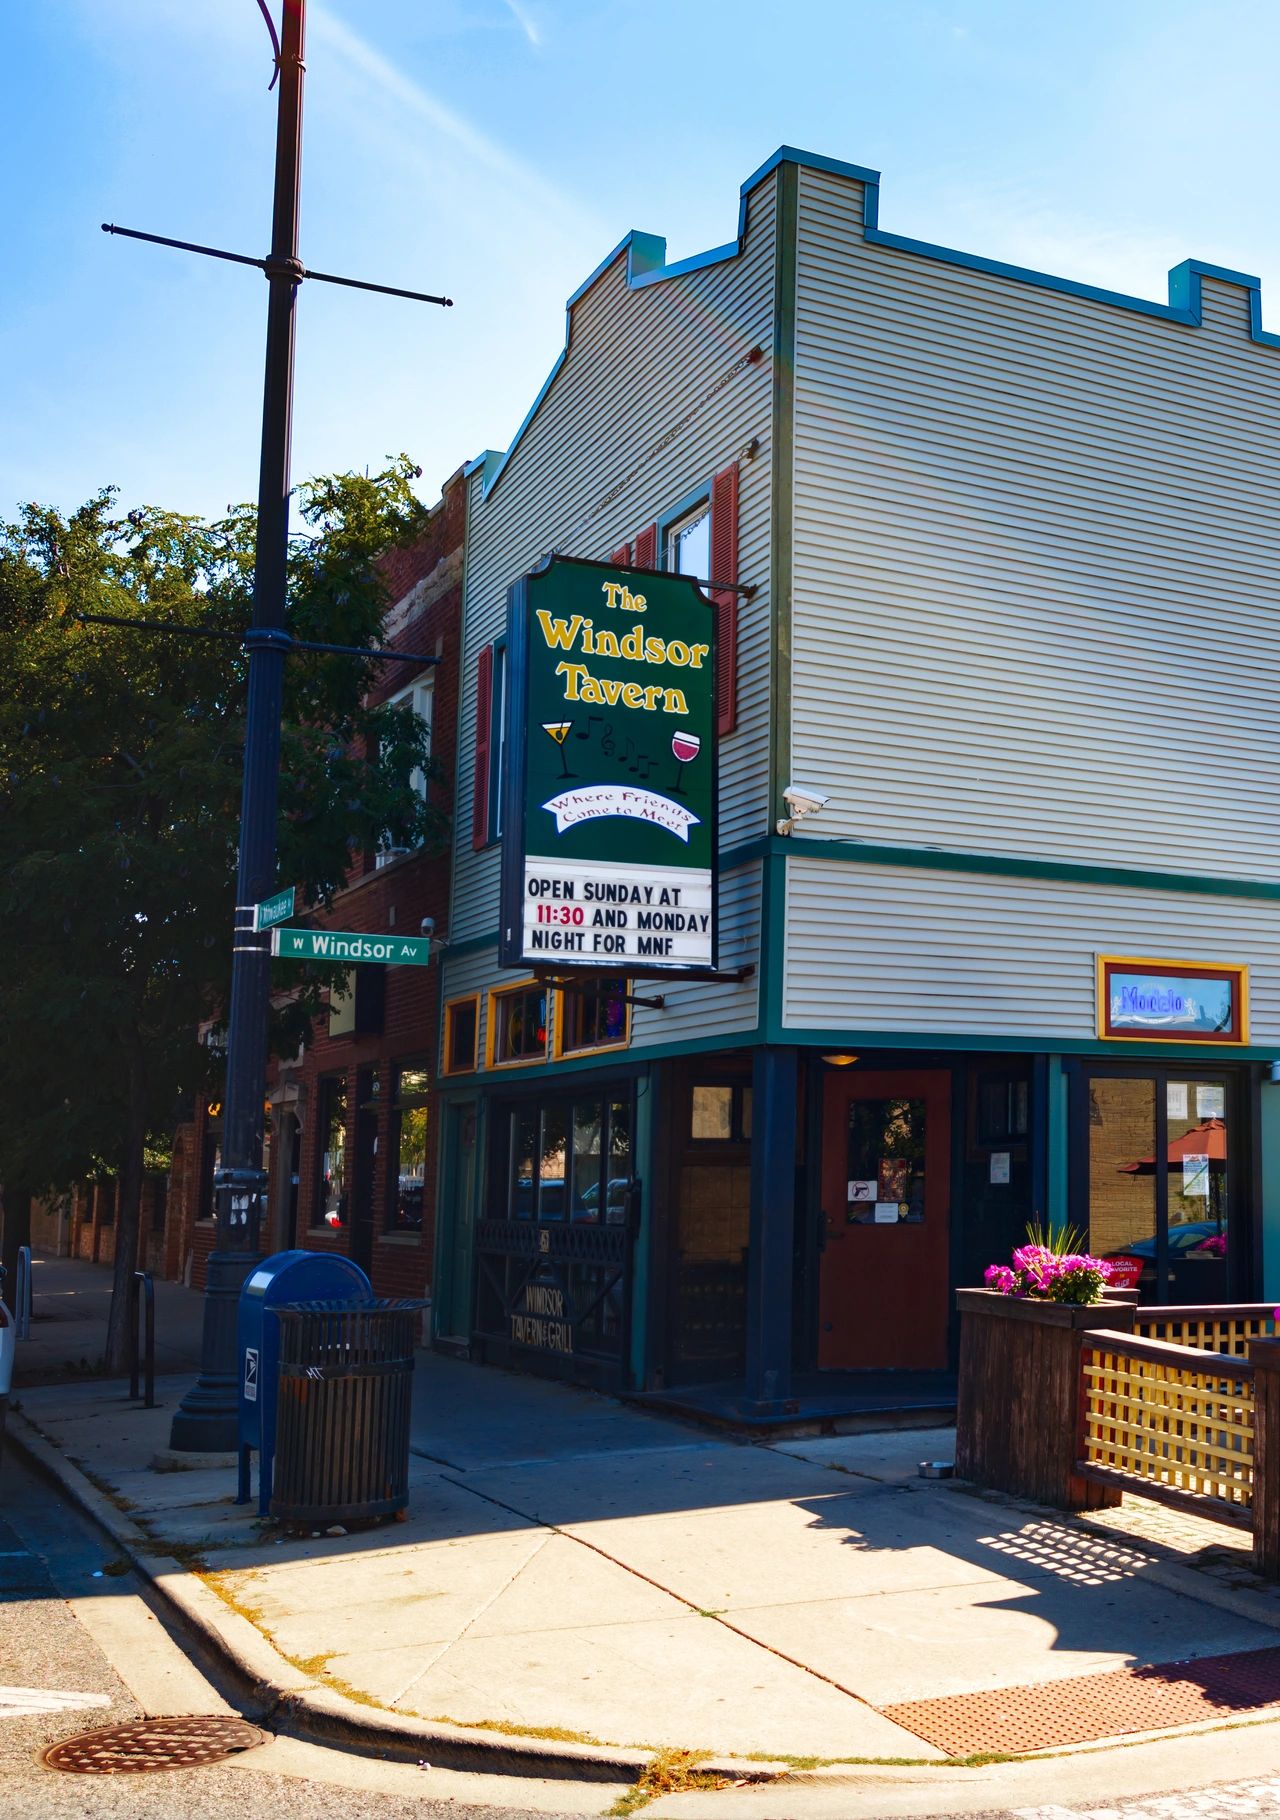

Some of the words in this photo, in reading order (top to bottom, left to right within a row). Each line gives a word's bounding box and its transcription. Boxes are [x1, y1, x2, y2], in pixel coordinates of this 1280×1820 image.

[602, 581, 647, 613] The
[536, 609, 710, 668] Windsor
[555, 661, 689, 714] Tavern
[550, 793, 614, 811] Where
[621, 791, 692, 822] Friends
[562, 806, 610, 823] Come
[615, 805, 632, 815] to
[528, 878, 575, 899] OPEN
[584, 882, 654, 904] SUNDAY
[658, 888, 681, 906] AT
[537, 904, 585, 926] 11:30
[592, 909, 628, 928] AND
[637, 911, 710, 932] MONDAY
[293, 938, 304, 950] W
[312, 935, 395, 959] Windsor
[400, 944, 418, 957] Av
[531, 930, 586, 952] NIGHT
[593, 934, 626, 953] FOR
[637, 936, 674, 955] MNF
[1121, 986, 1184, 1013] Modelo
[526, 1285, 564, 1319] WINDSOR
[511, 1314, 543, 1347] TAVERN
[548, 1321, 573, 1353] GRILL
